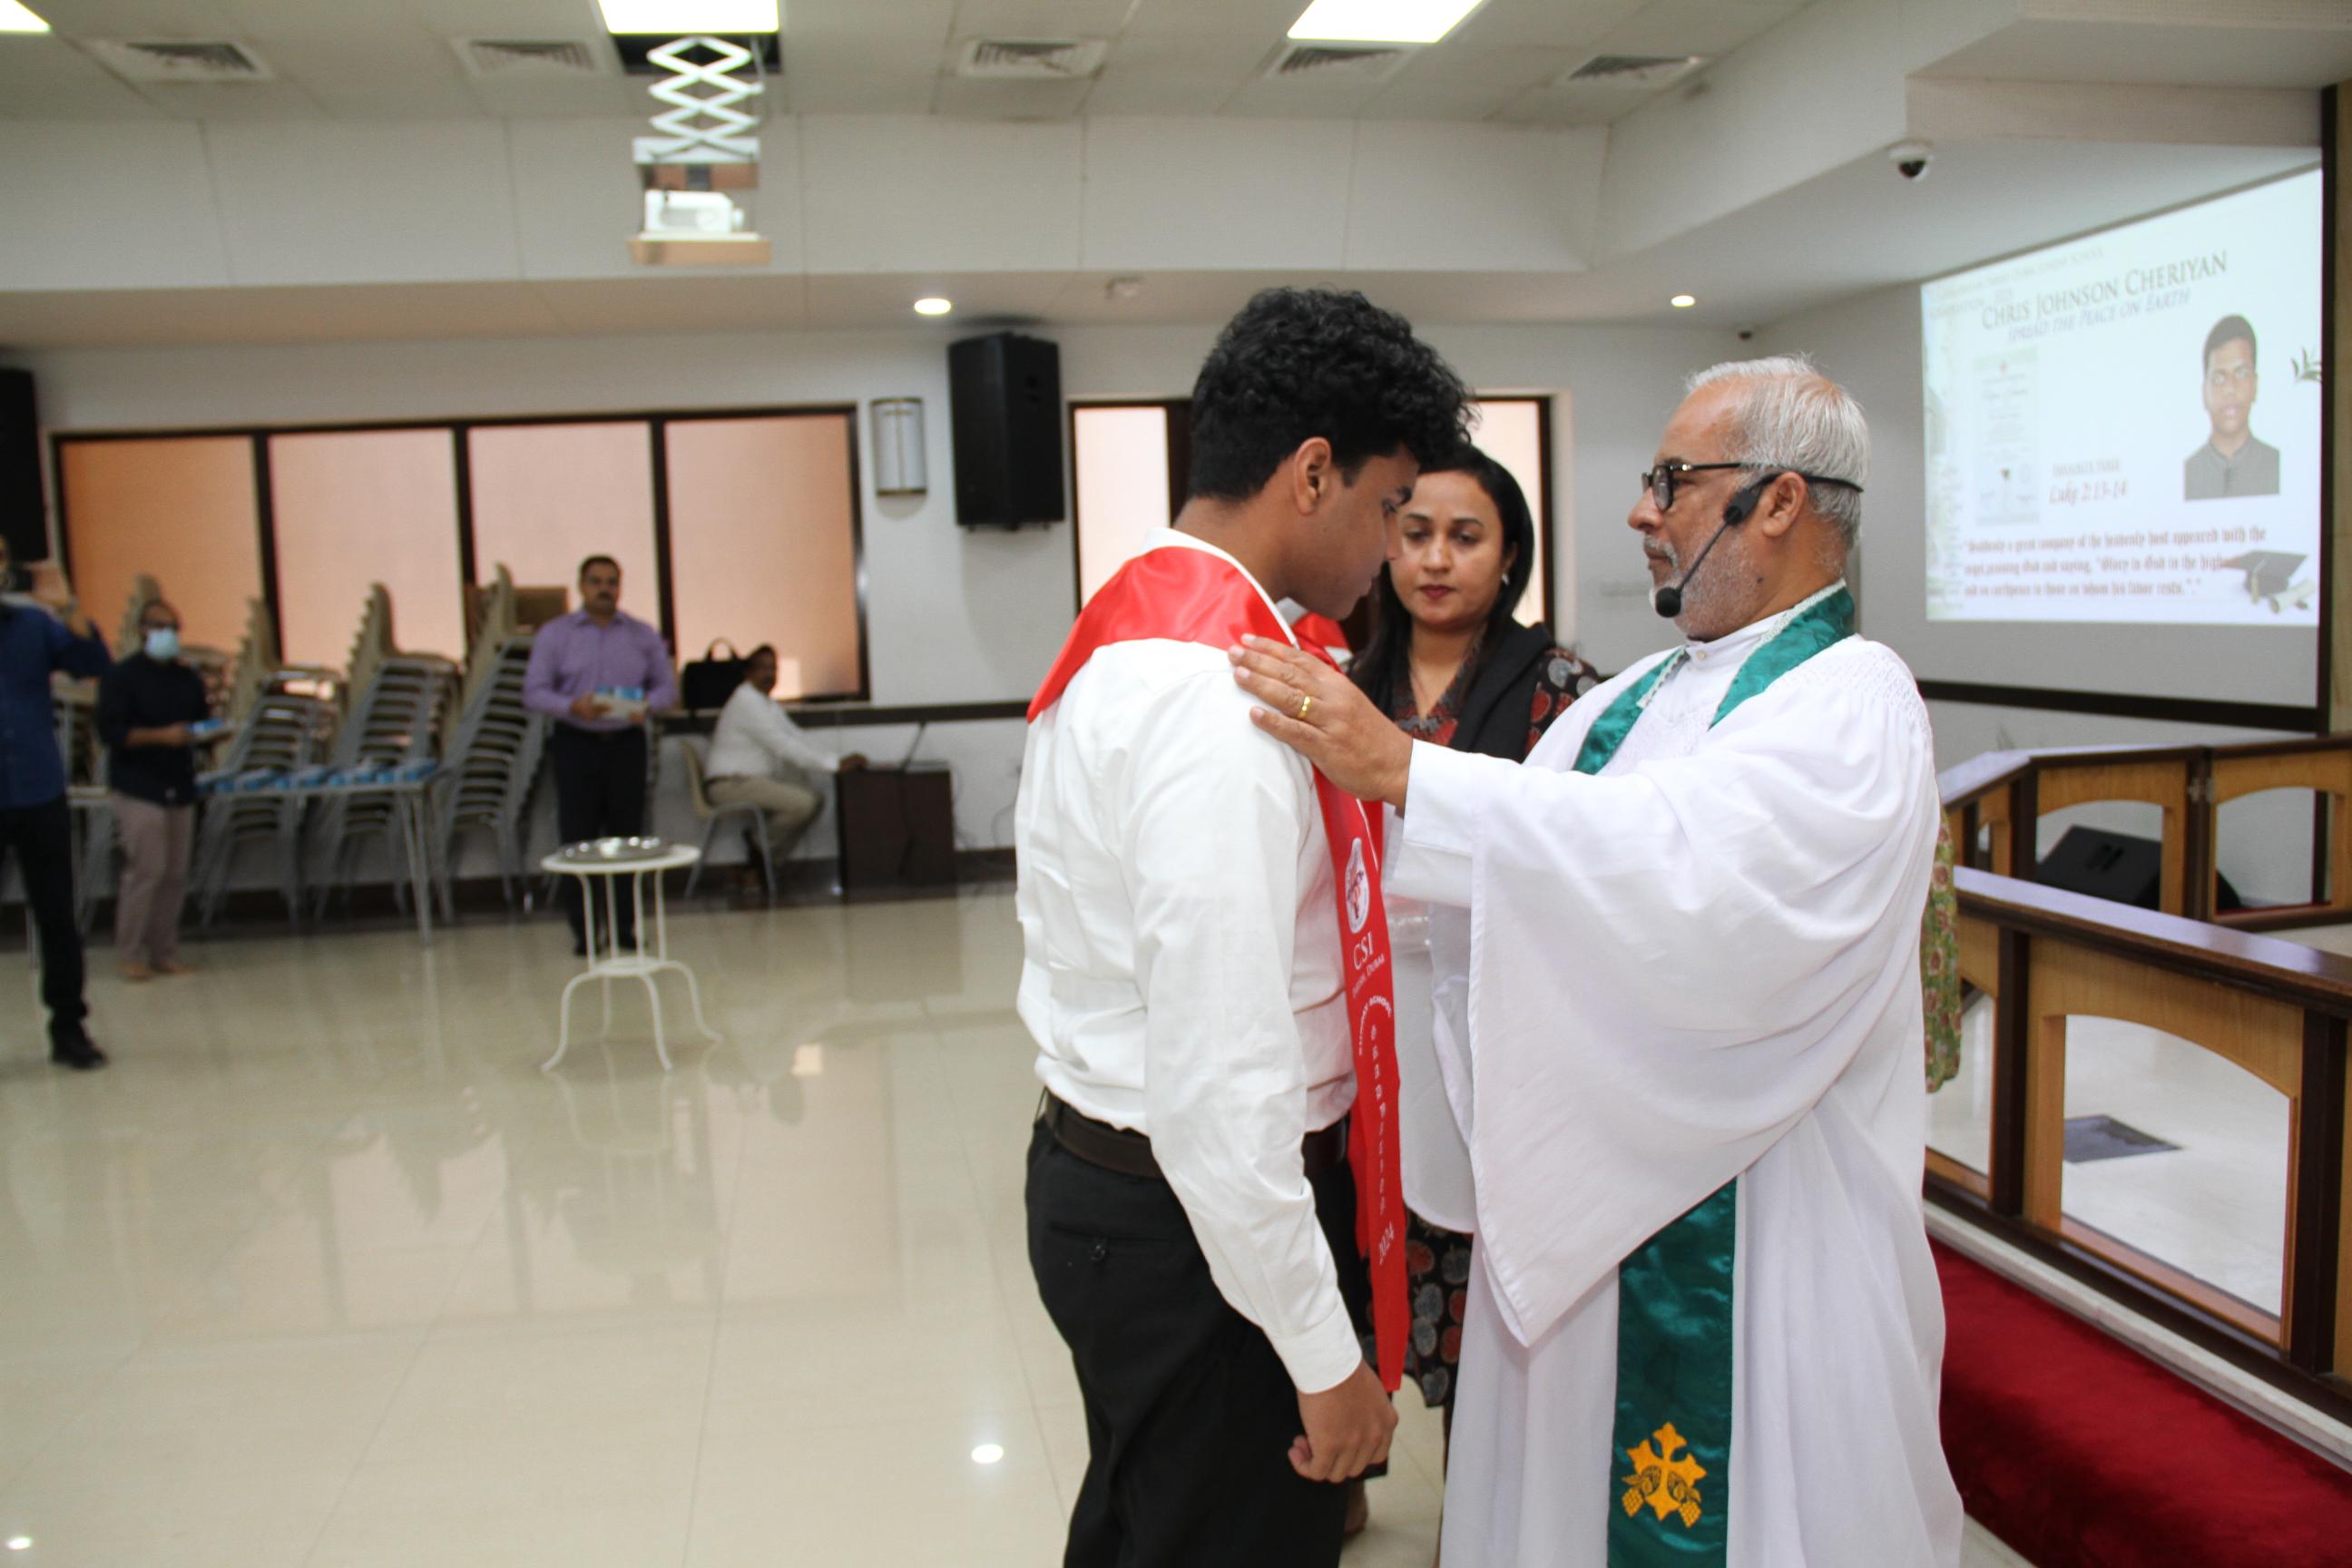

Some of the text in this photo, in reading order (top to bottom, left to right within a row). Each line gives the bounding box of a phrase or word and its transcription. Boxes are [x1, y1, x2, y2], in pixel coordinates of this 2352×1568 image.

[1981, 301, 2031, 330] CHRIS
[2036, 277, 2119, 320] JOHNSON
[2124, 250, 2229, 296] CHERIYAN
[2119, 299, 2141, 318] ON
[2144, 287, 2192, 311] EARTH
[2221, 525, 2246, 544] with
[1353, 930, 1374, 970] CSI
[1368, 995, 1392, 1018] SCHOOL
